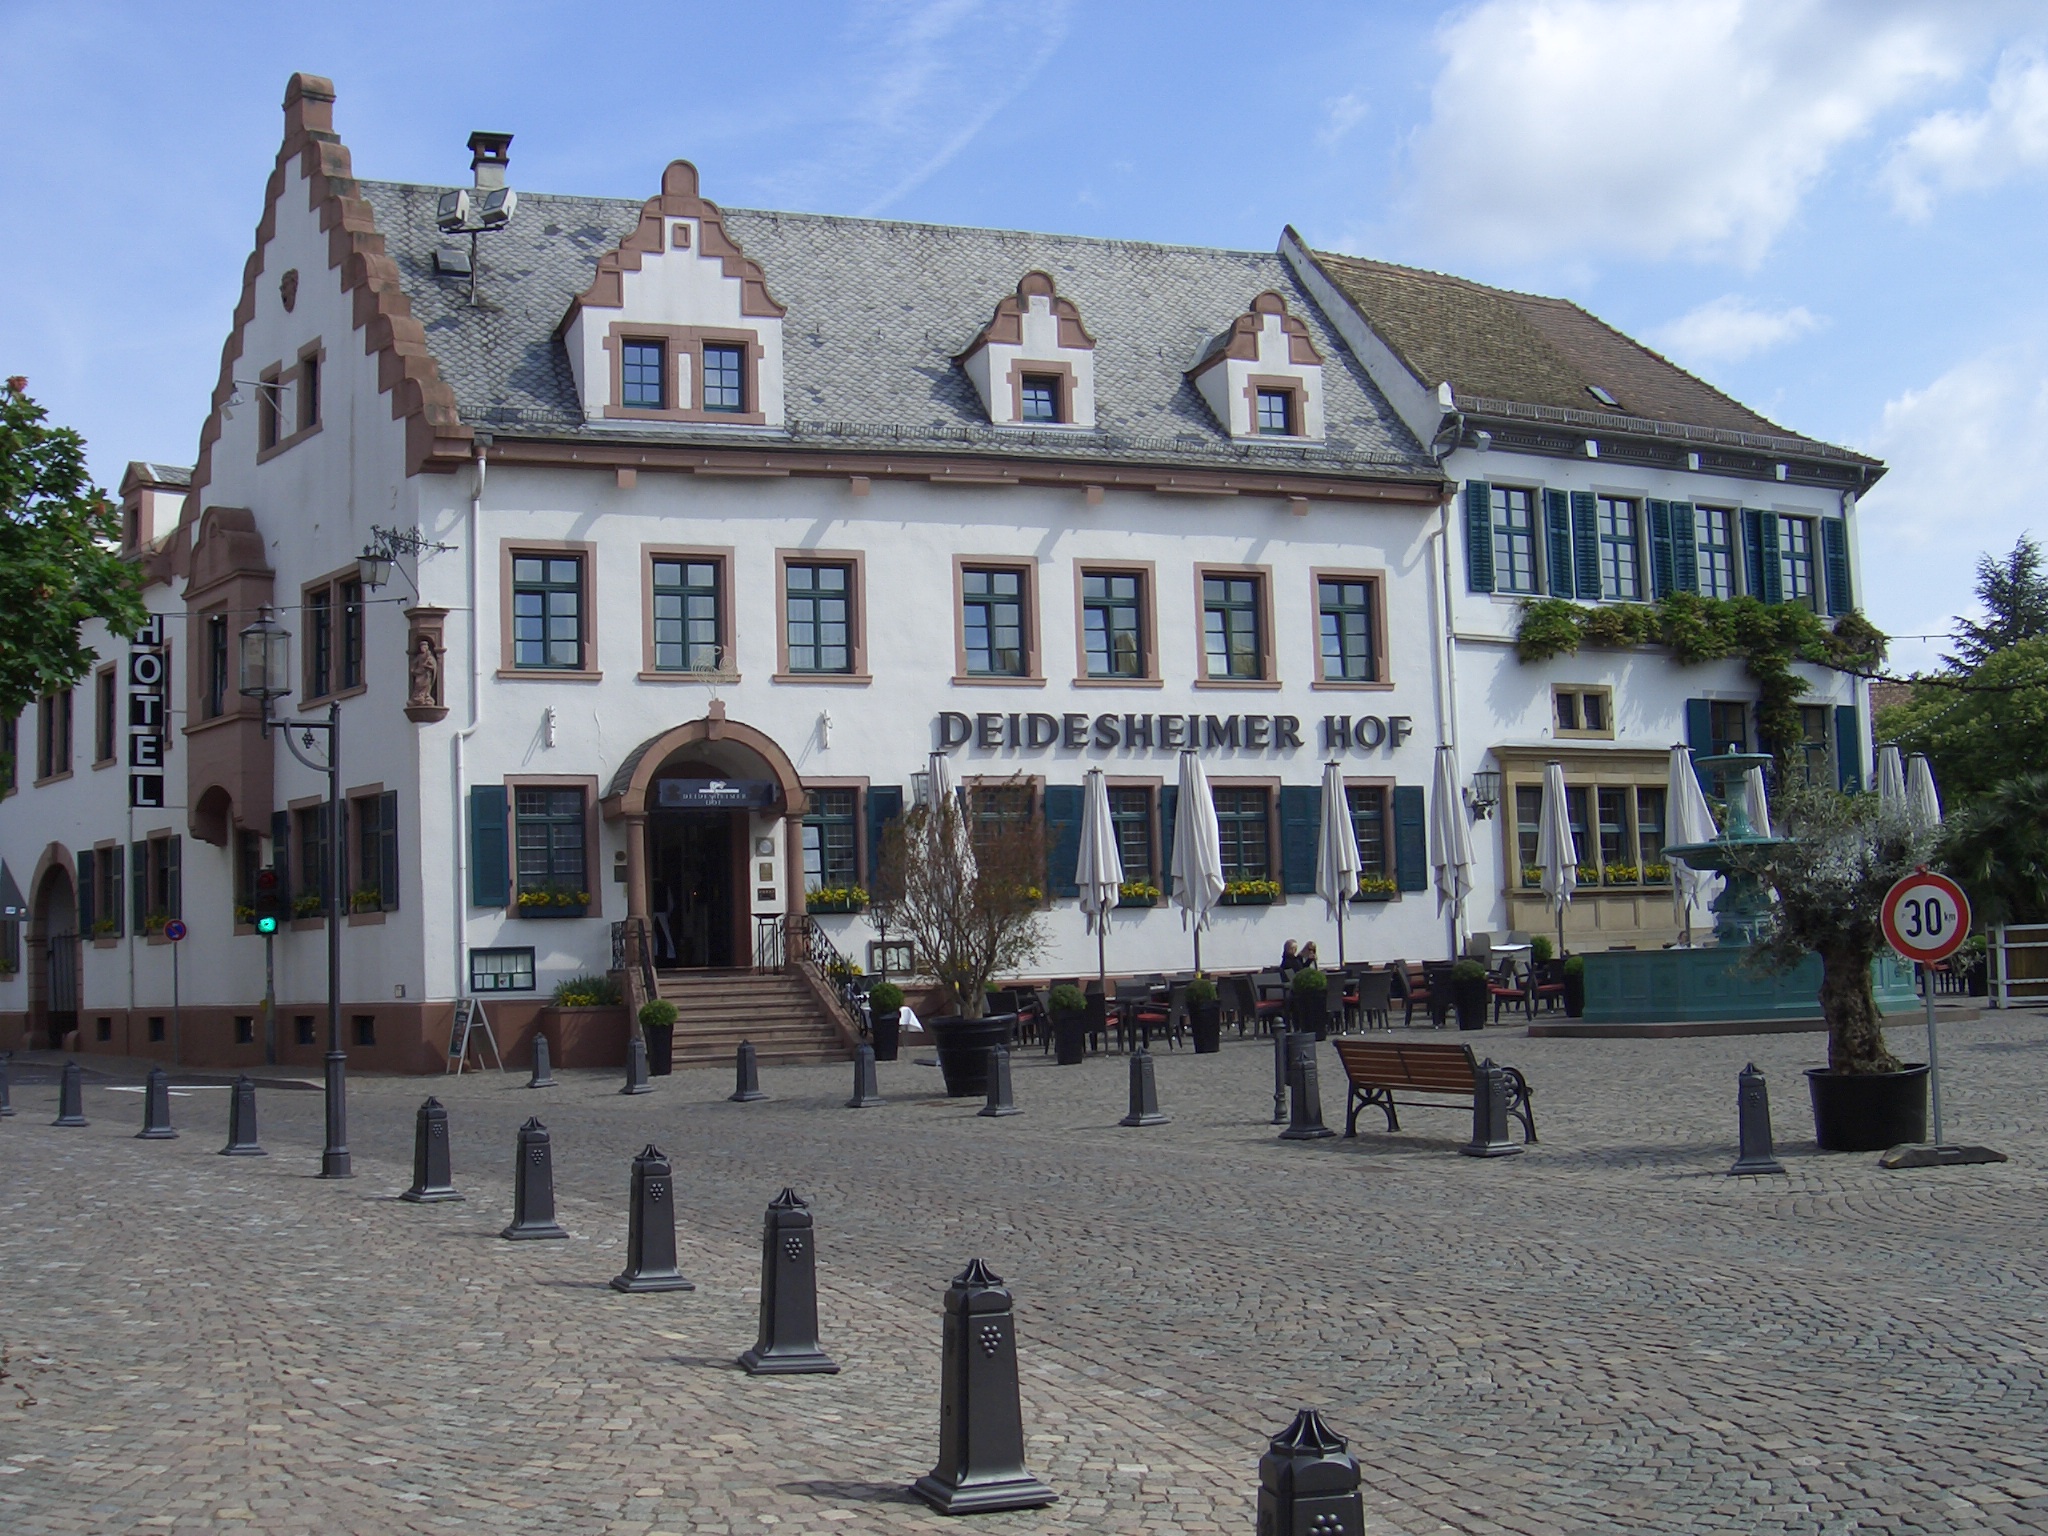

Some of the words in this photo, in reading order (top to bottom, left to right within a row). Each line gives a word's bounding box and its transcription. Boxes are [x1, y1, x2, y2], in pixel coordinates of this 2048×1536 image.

[134, 615, 162, 806] HOTEL
[938, 711, 1305, 750] DEIDESHEIMER
[1324, 715, 1413, 750] HOF
[1904, 897, 1942, 937] 30
